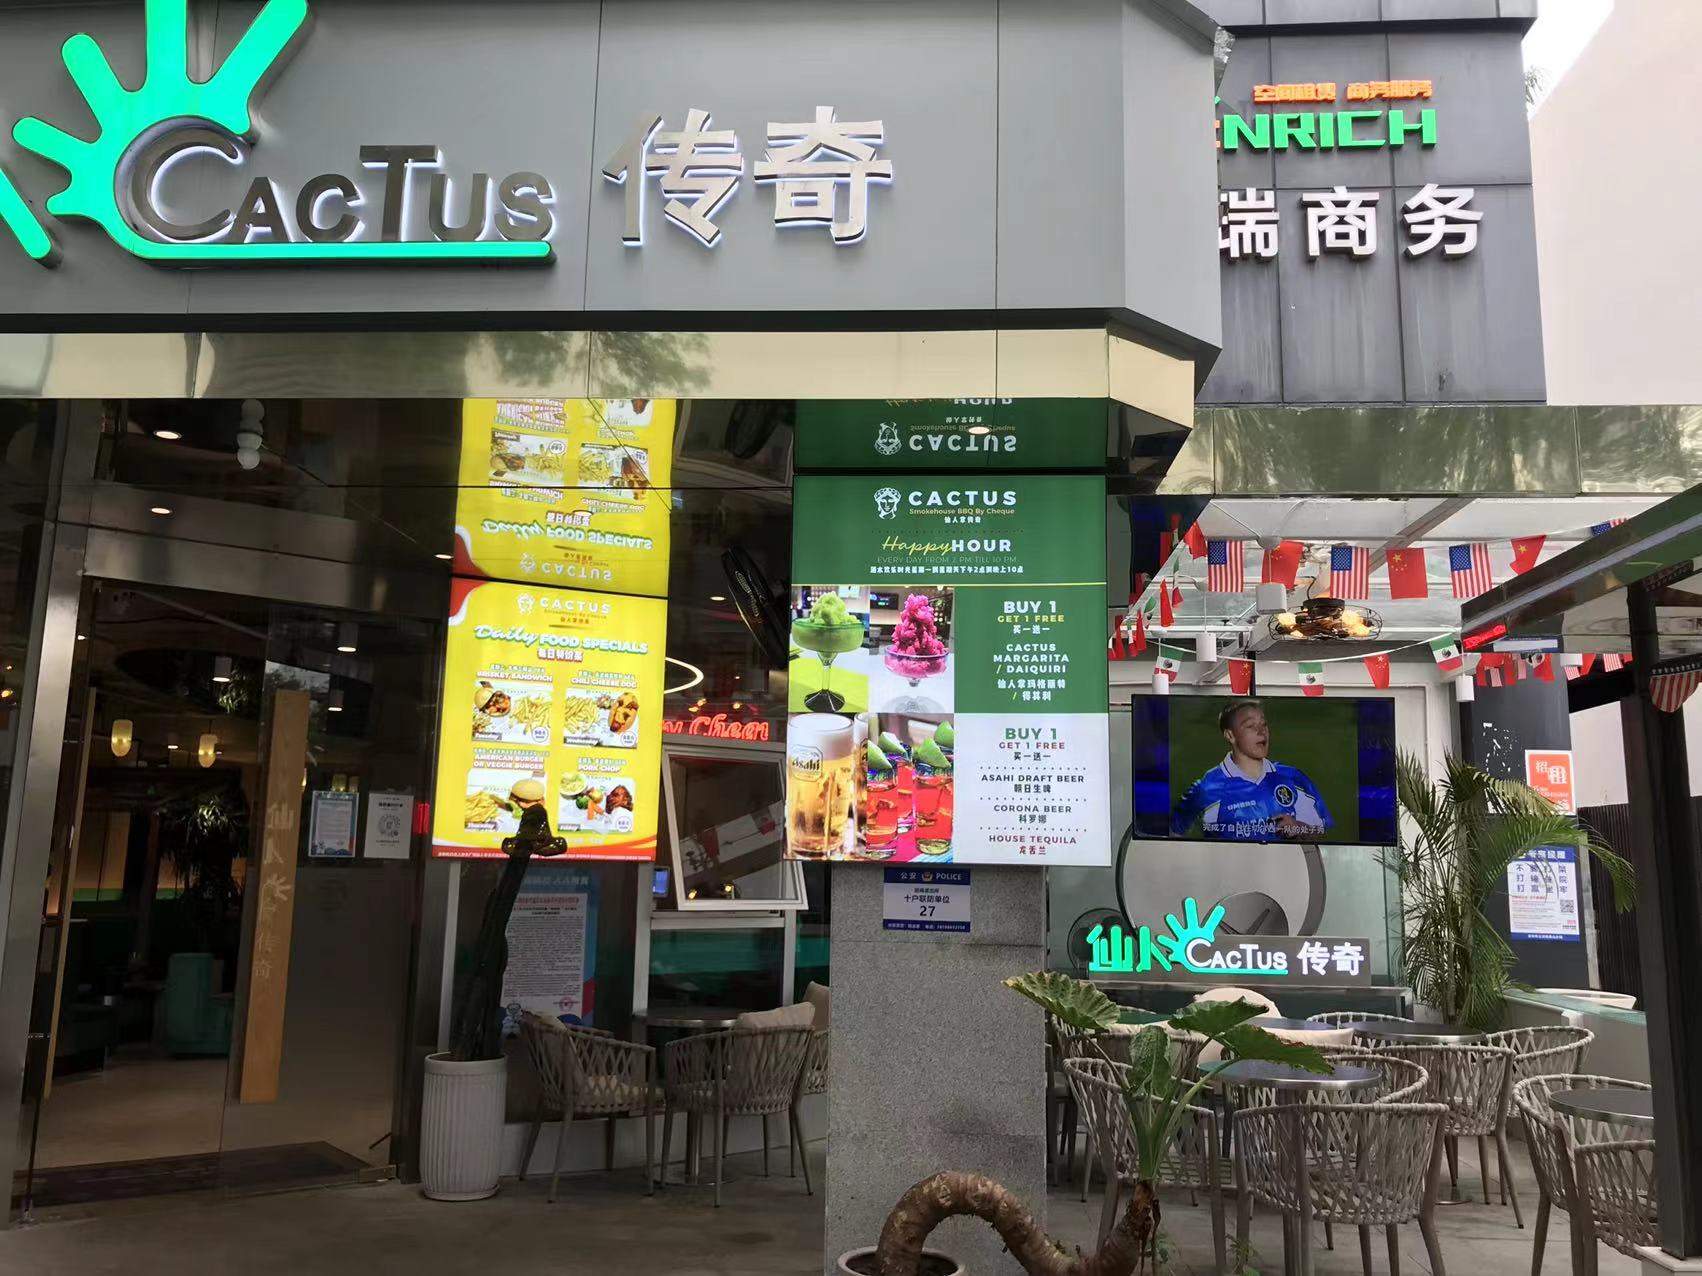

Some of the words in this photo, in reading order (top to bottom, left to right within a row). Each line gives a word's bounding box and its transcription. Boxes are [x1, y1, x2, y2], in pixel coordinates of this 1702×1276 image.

[1215, 109, 1437, 150] NRICH
[602, 106, 892, 247] 传奇
[908, 490, 1017, 506] CACTUS
[957, 508, 974, 516] BBQ
[975, 508, 985, 516] By
[986, 508, 1015, 516] Cheque
[882, 535, 953, 556] Happy
[951, 539, 1012, 552] HOUR
[878, 556, 903, 564] EVERY
[905, 556, 923, 564] DAY
[925, 556, 950, 564] FROM
[959, 556, 973, 564] PM
[975, 556, 989, 564] TILL
[1003, 556, 1017, 564] PM
[540, 597, 612, 615] CACTUS
[1004, 601, 1041, 614] BUY
[1049, 601, 1057, 613] 1
[997, 615, 1020, 623] GET
[1025, 615, 1029, 623] 1
[1035, 615, 1065, 623] FREE
[1013, 625, 1050, 635] 买一送一
[539, 634, 580, 649] FOOD
[582, 636, 649, 654] SPECIALS
[1006, 644, 1056, 652] CACTUS
[993, 654, 1070, 663] MARGARITA
[1006, 665, 1066, 674] DAIQUIRI
[1005, 728, 1042, 740] BUY
[1050, 728, 1057, 740] 1
[999, 742, 1021, 750] GET
[1026, 742, 1030, 750] 1
[1036, 742, 1065, 750] FREE
[1014, 752, 1051, 761] 买一送一
[981, 774, 1014, 782] ASAHI
[1018, 774, 1053, 783] DRAFT
[1057, 775, 1084, 783] BEER
[1014, 784, 1051, 793] 朝日生啤
[994, 805, 1039, 813] CORONA
[1043, 805, 1072, 813] BEER
[988, 835, 1026, 843] HOUSE
[1030, 836, 1077, 845] TEQUILA
[936, 872, 962, 881] POLICE
[919, 905, 936, 917] 27
[1297, 941, 1364, 977] 传奇
